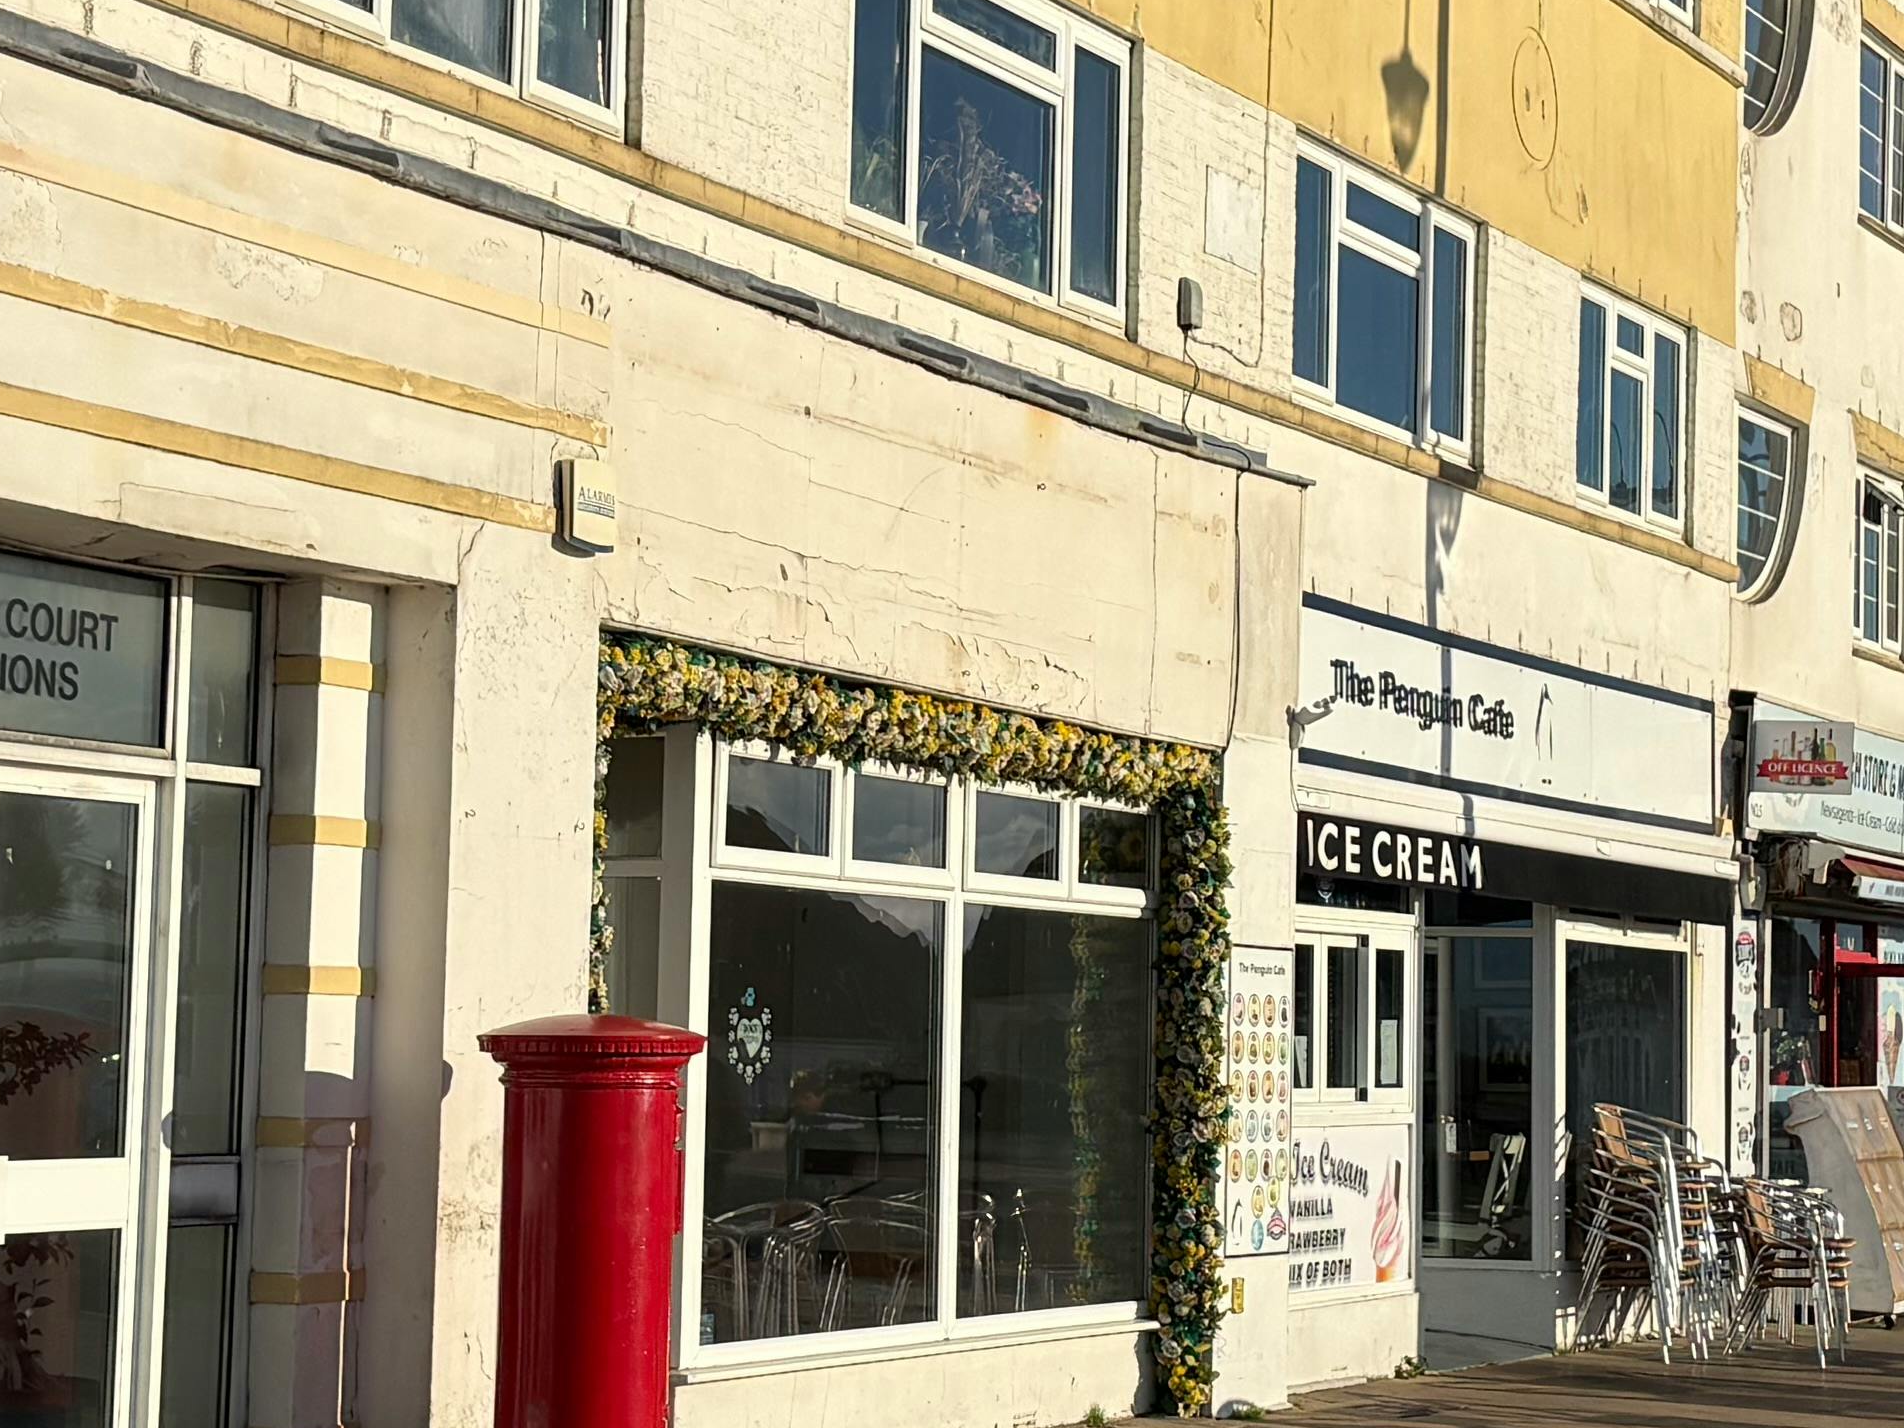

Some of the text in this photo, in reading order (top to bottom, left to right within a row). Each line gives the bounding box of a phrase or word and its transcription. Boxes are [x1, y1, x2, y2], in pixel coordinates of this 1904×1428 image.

[5, 598, 119, 652] COURT
[1330, 658, 1375, 707] The
[1378, 671, 1464, 732] Penguin
[1768, 763, 1838, 775] OFF LICENCE
[1306, 818, 1484, 891] ICE CREAM
[1319, 1139, 1368, 1195] Cream
[1306, 1261, 1320, 1281] OF
[1322, 1258, 1352, 1279] BOTH
